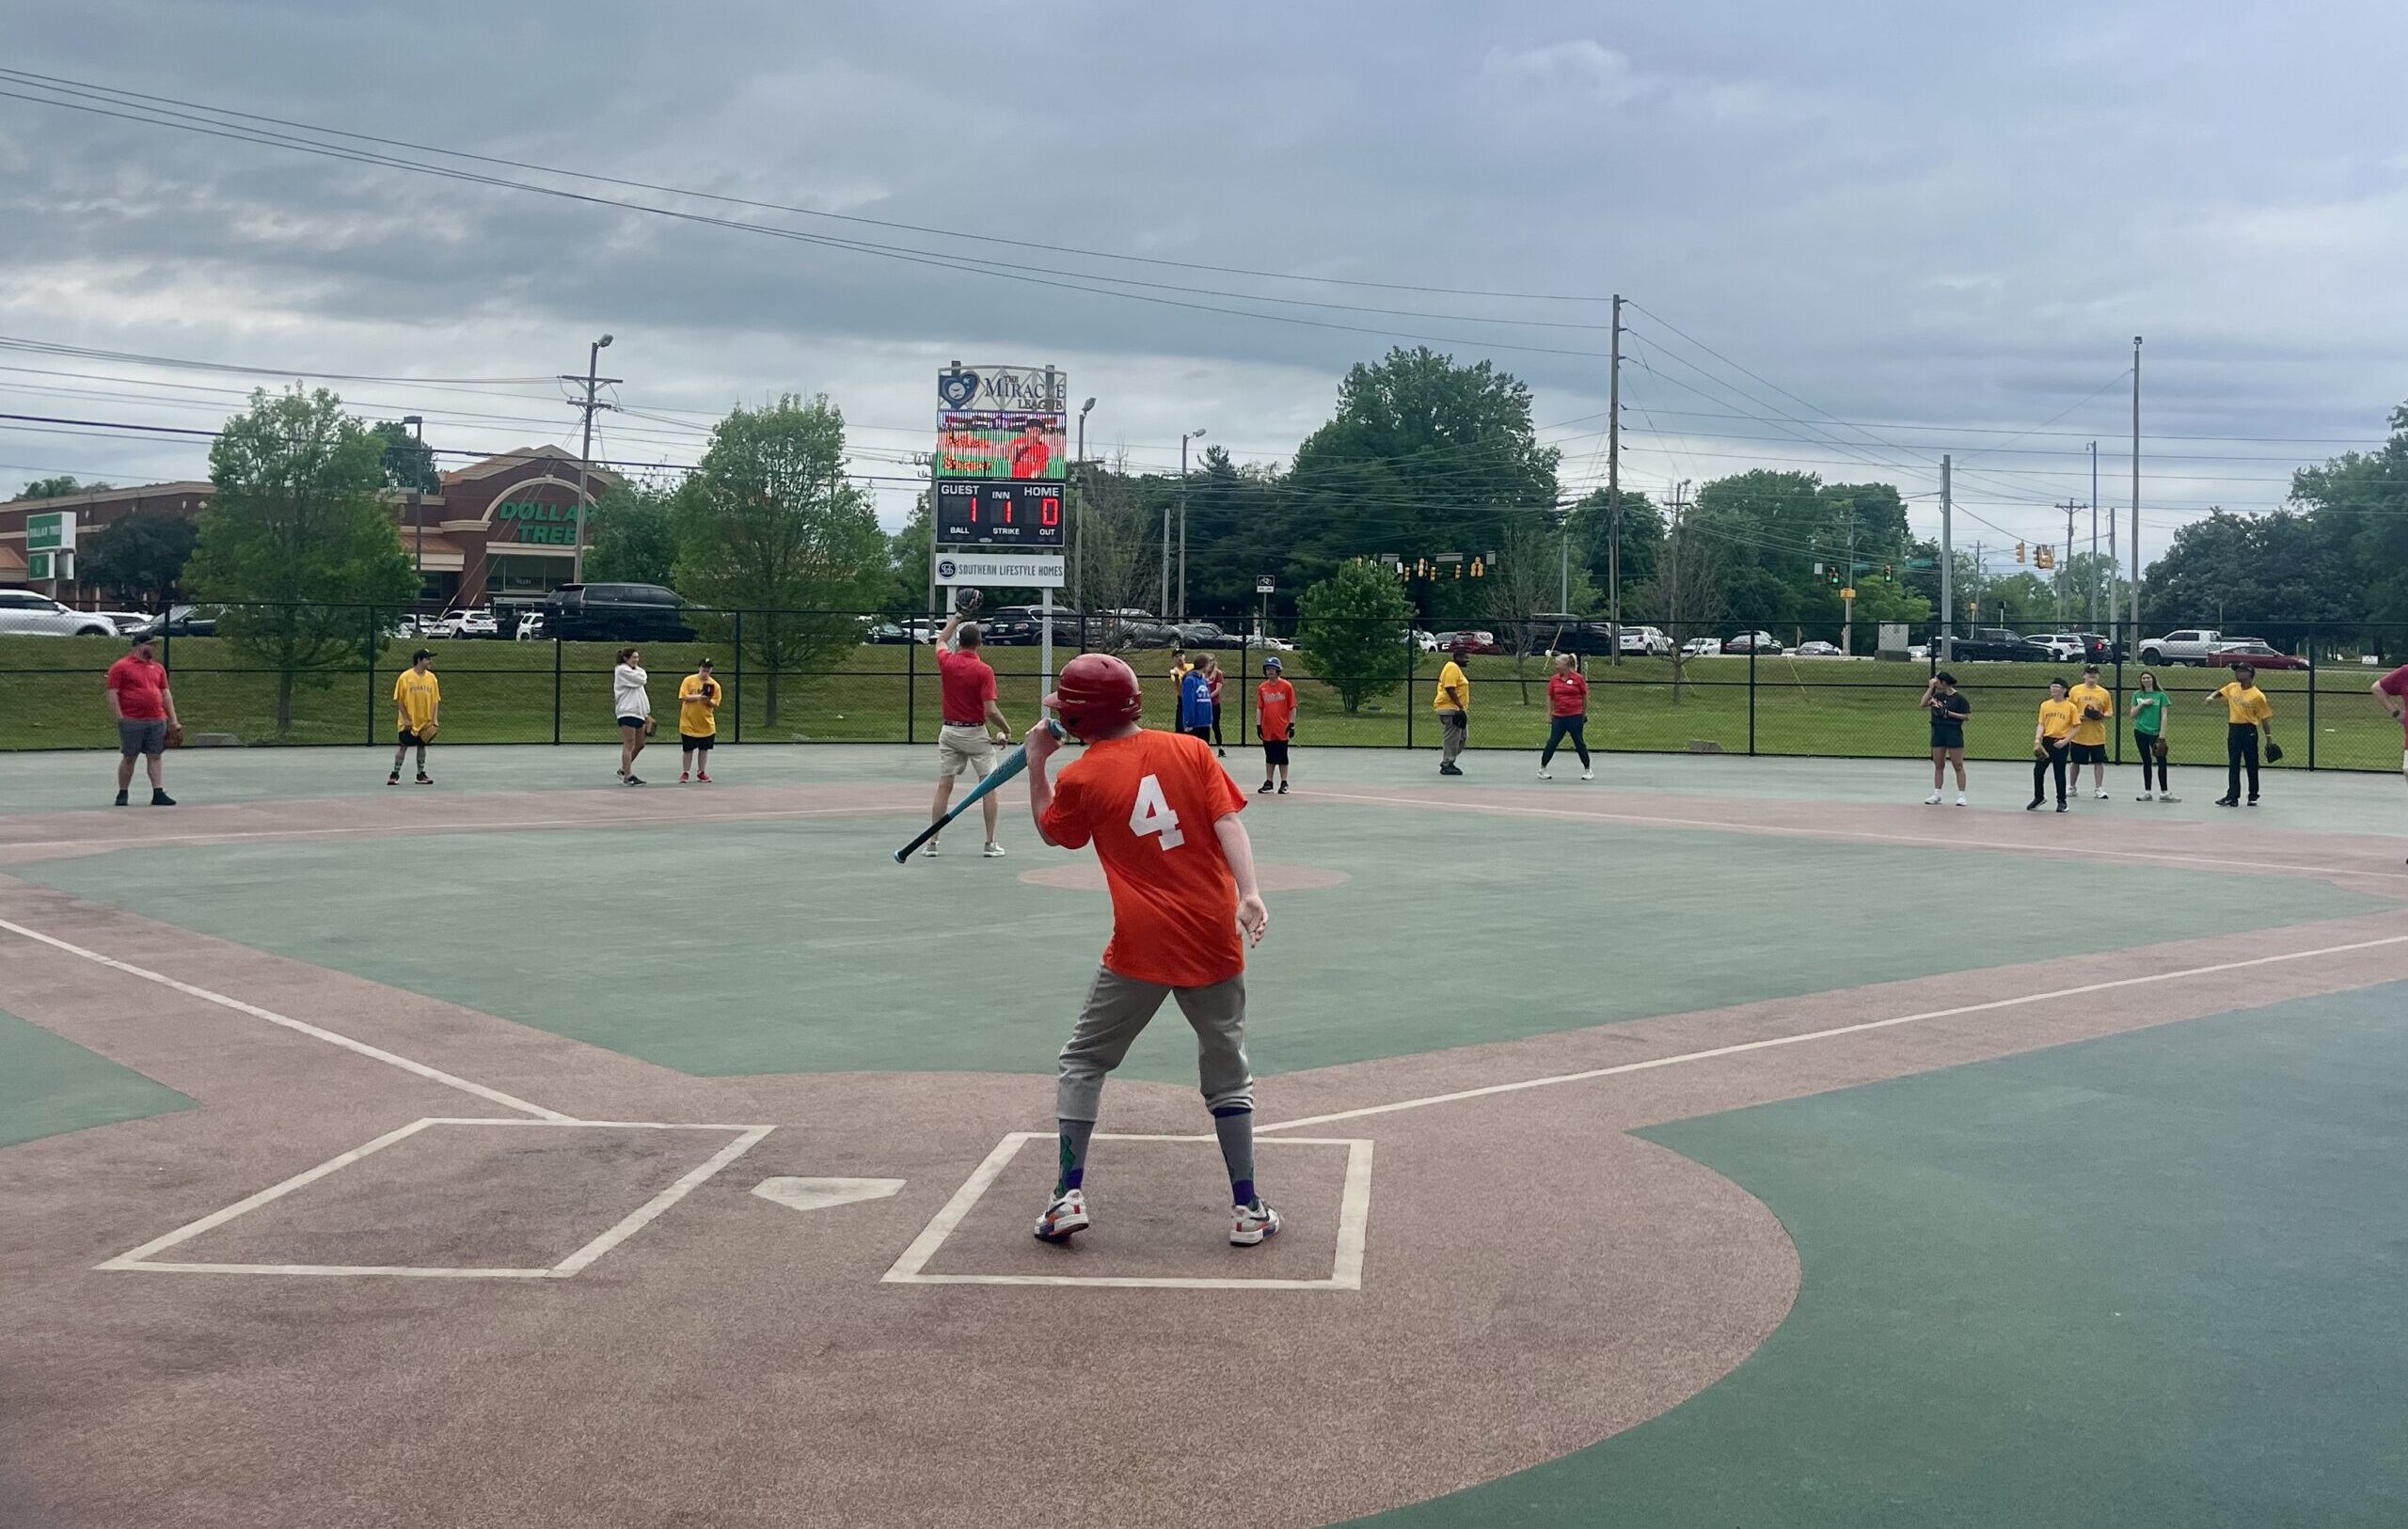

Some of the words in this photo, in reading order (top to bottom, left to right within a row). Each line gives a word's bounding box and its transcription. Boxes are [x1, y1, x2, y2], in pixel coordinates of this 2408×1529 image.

[984, 378, 1065, 399] MIRACLE
[1003, 375, 1019, 384] THE
[941, 484, 980, 496] GUEST
[991, 491, 1011, 499] INN
[1023, 486, 1059, 497] HOME
[970, 497, 977, 523] 1
[1004, 500, 1012, 524] 1
[1041, 497, 1059, 526] 0
[518, 524, 577, 544] TREE
[958, 564, 997, 575] SOUTHERN
[999, 564, 1036, 576] LIFESTYLE
[1038, 565, 1063, 576] HOMES
[1129, 773, 1185, 851] 4
